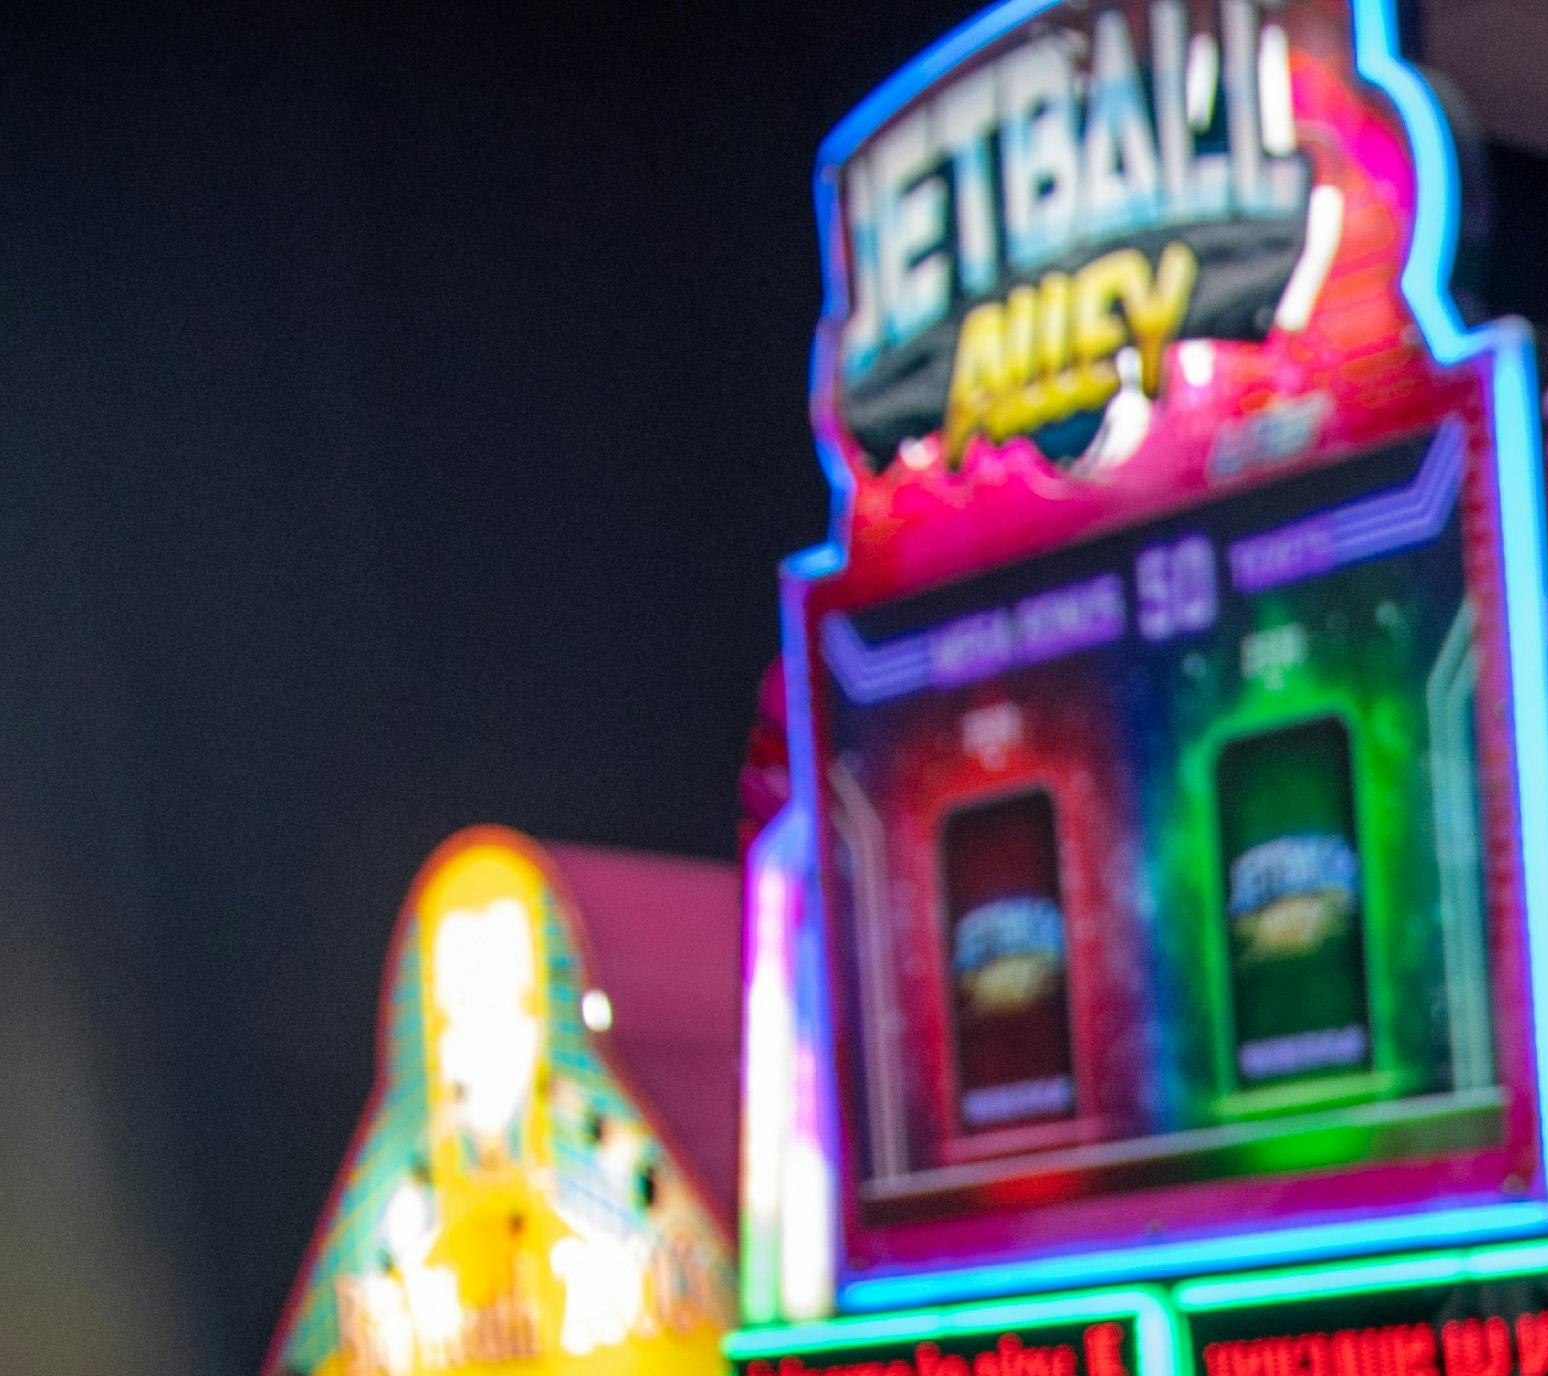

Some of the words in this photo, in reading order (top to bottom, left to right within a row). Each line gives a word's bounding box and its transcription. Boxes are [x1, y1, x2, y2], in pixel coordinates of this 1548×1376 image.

[843, 0, 1310, 376] JETBALL
[944, 241, 1198, 470] ALLEY
[1136, 534, 1217, 642] 50
